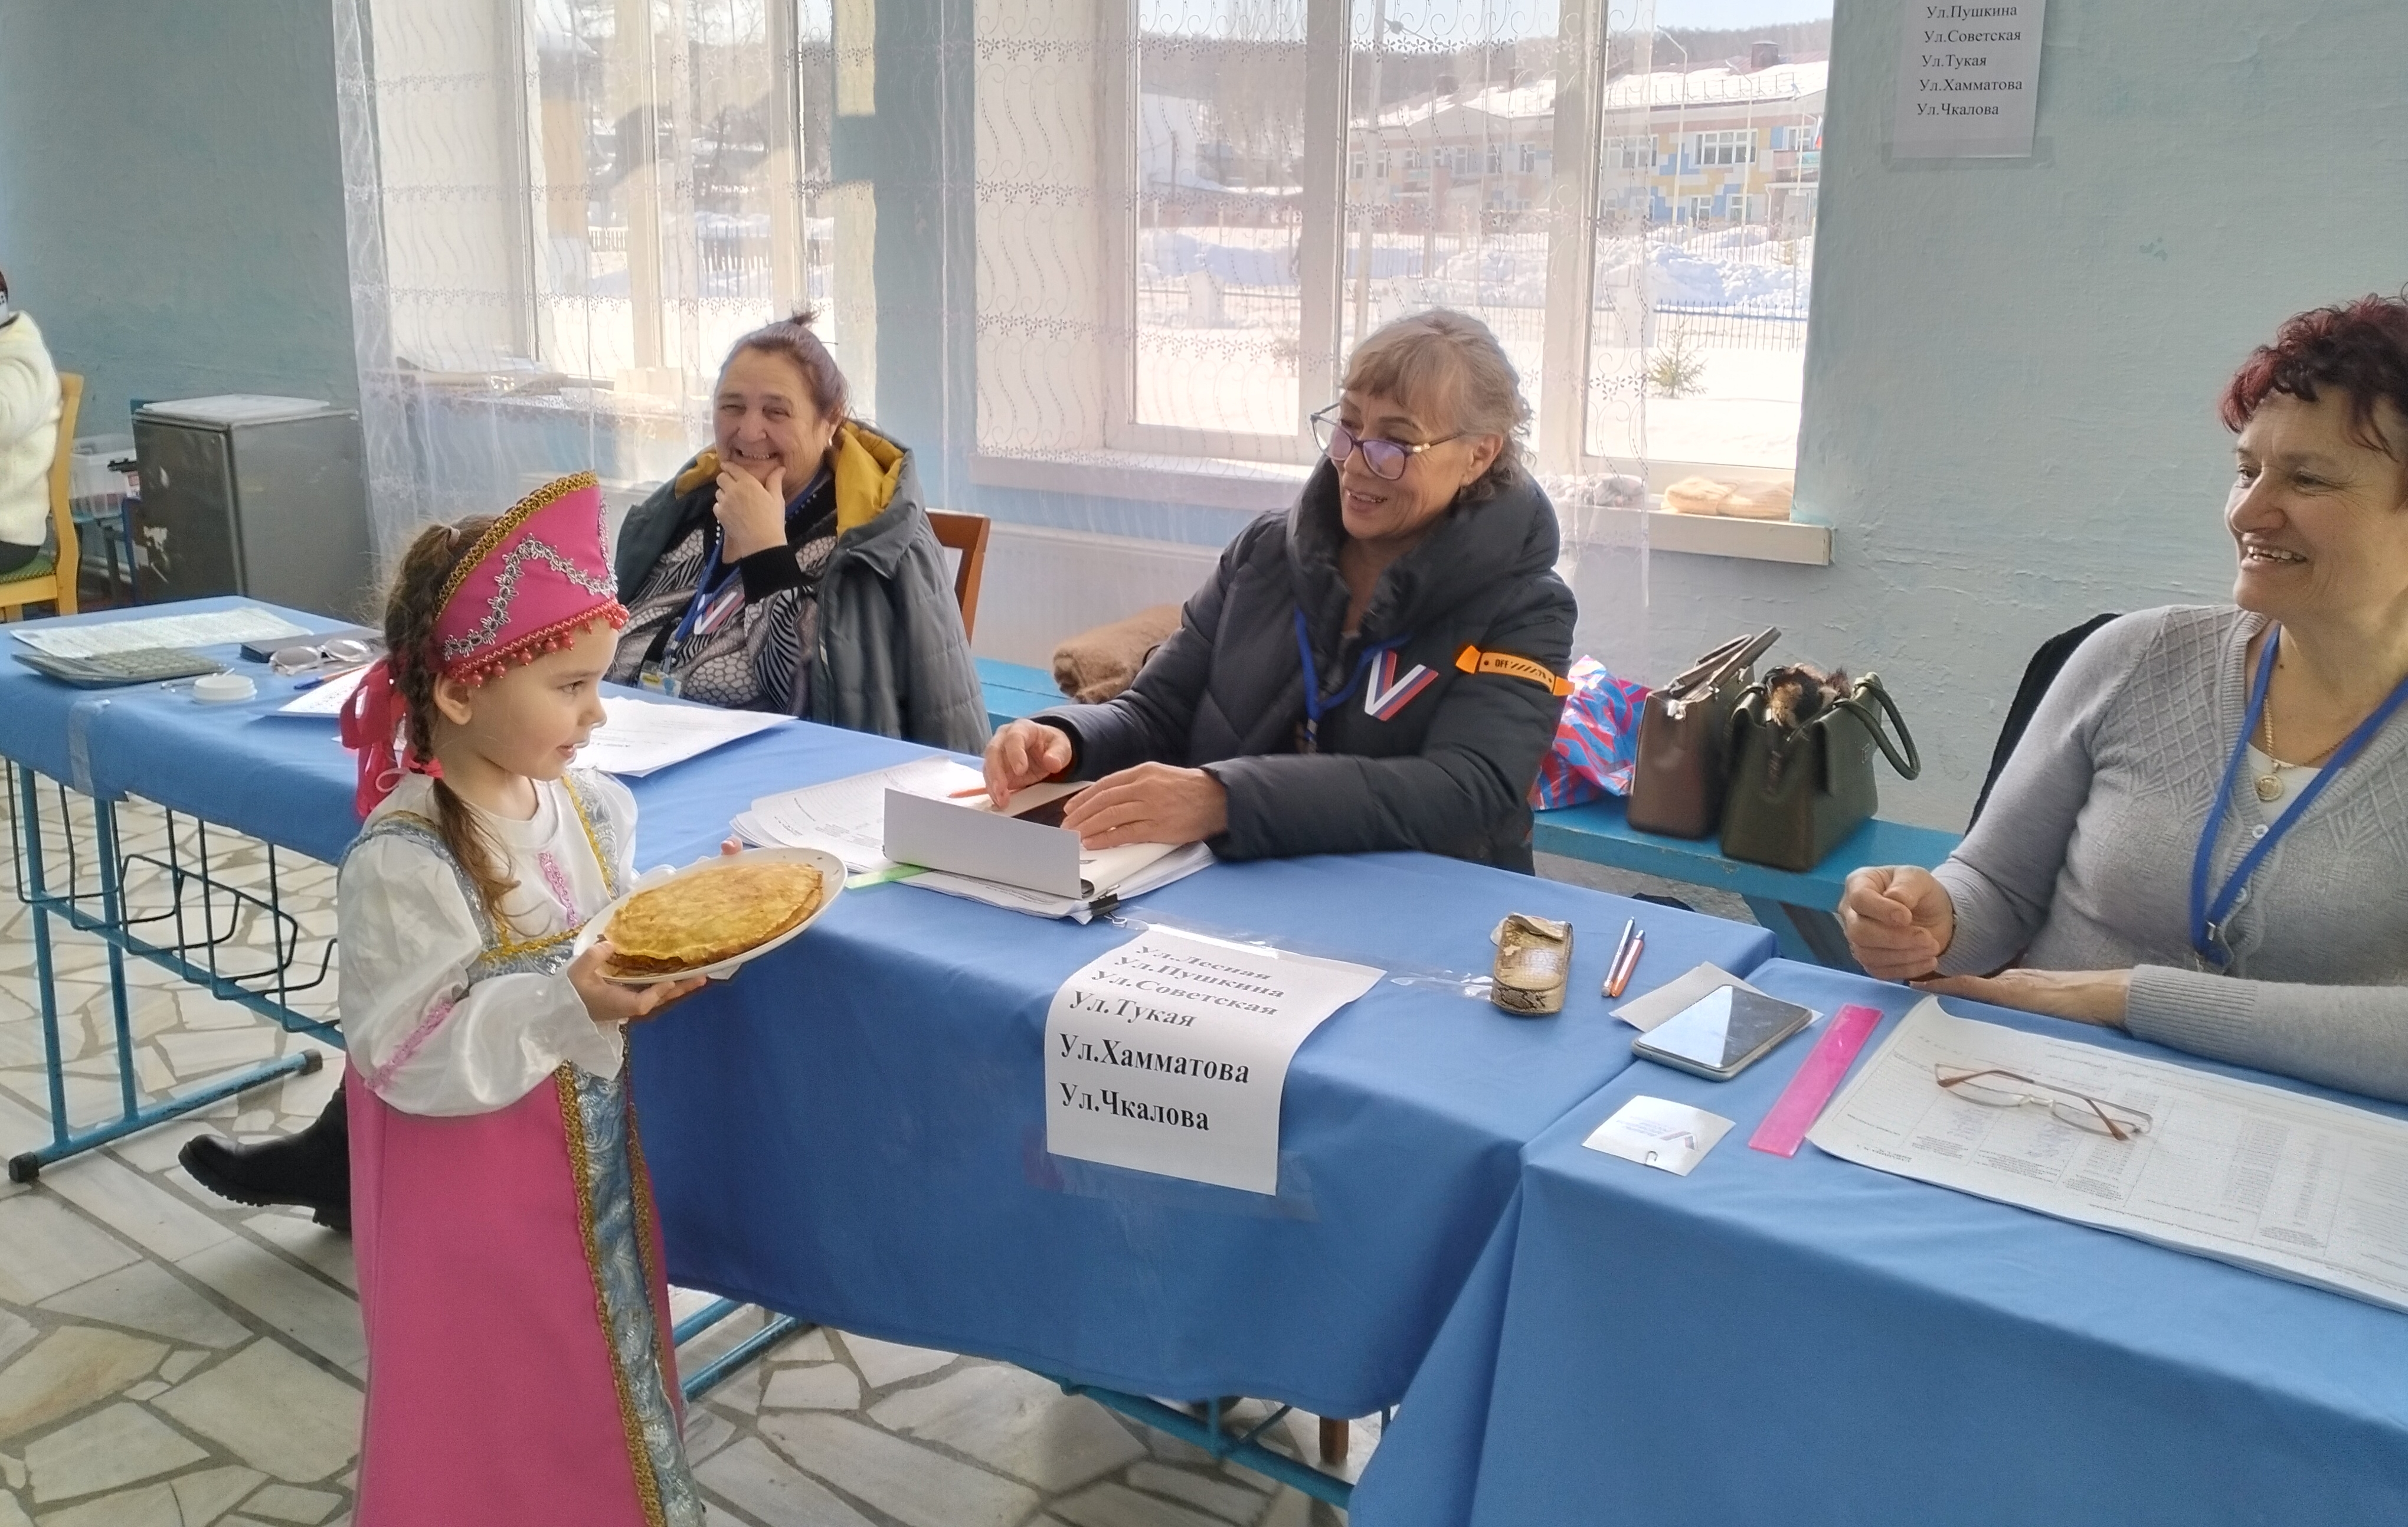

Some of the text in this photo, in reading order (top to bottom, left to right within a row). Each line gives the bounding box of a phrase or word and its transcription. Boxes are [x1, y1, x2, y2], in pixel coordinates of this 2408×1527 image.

[1926, 5, 2018, 21] Ул.Пушкина
[1924, 30, 2021, 43] Ул.Советская
[1922, 54, 1987, 70] Ул.Тукая
[1919, 79, 2023, 91] Ул.Хамматова
[1917, 103, 1999, 116] Ул.Чкалова
[1495, 658, 1509, 668] OFF
[1114, 956, 1285, 998] Ул.Пушкина
[1091, 970, 1278, 1015] Ул.Советская
[1069, 990, 1198, 1028] Ул.Тукая
[1059, 1032, 1249, 1084] Ул.Хамматова
[1059, 1081, 1210, 1132] Ул.Чкалова
